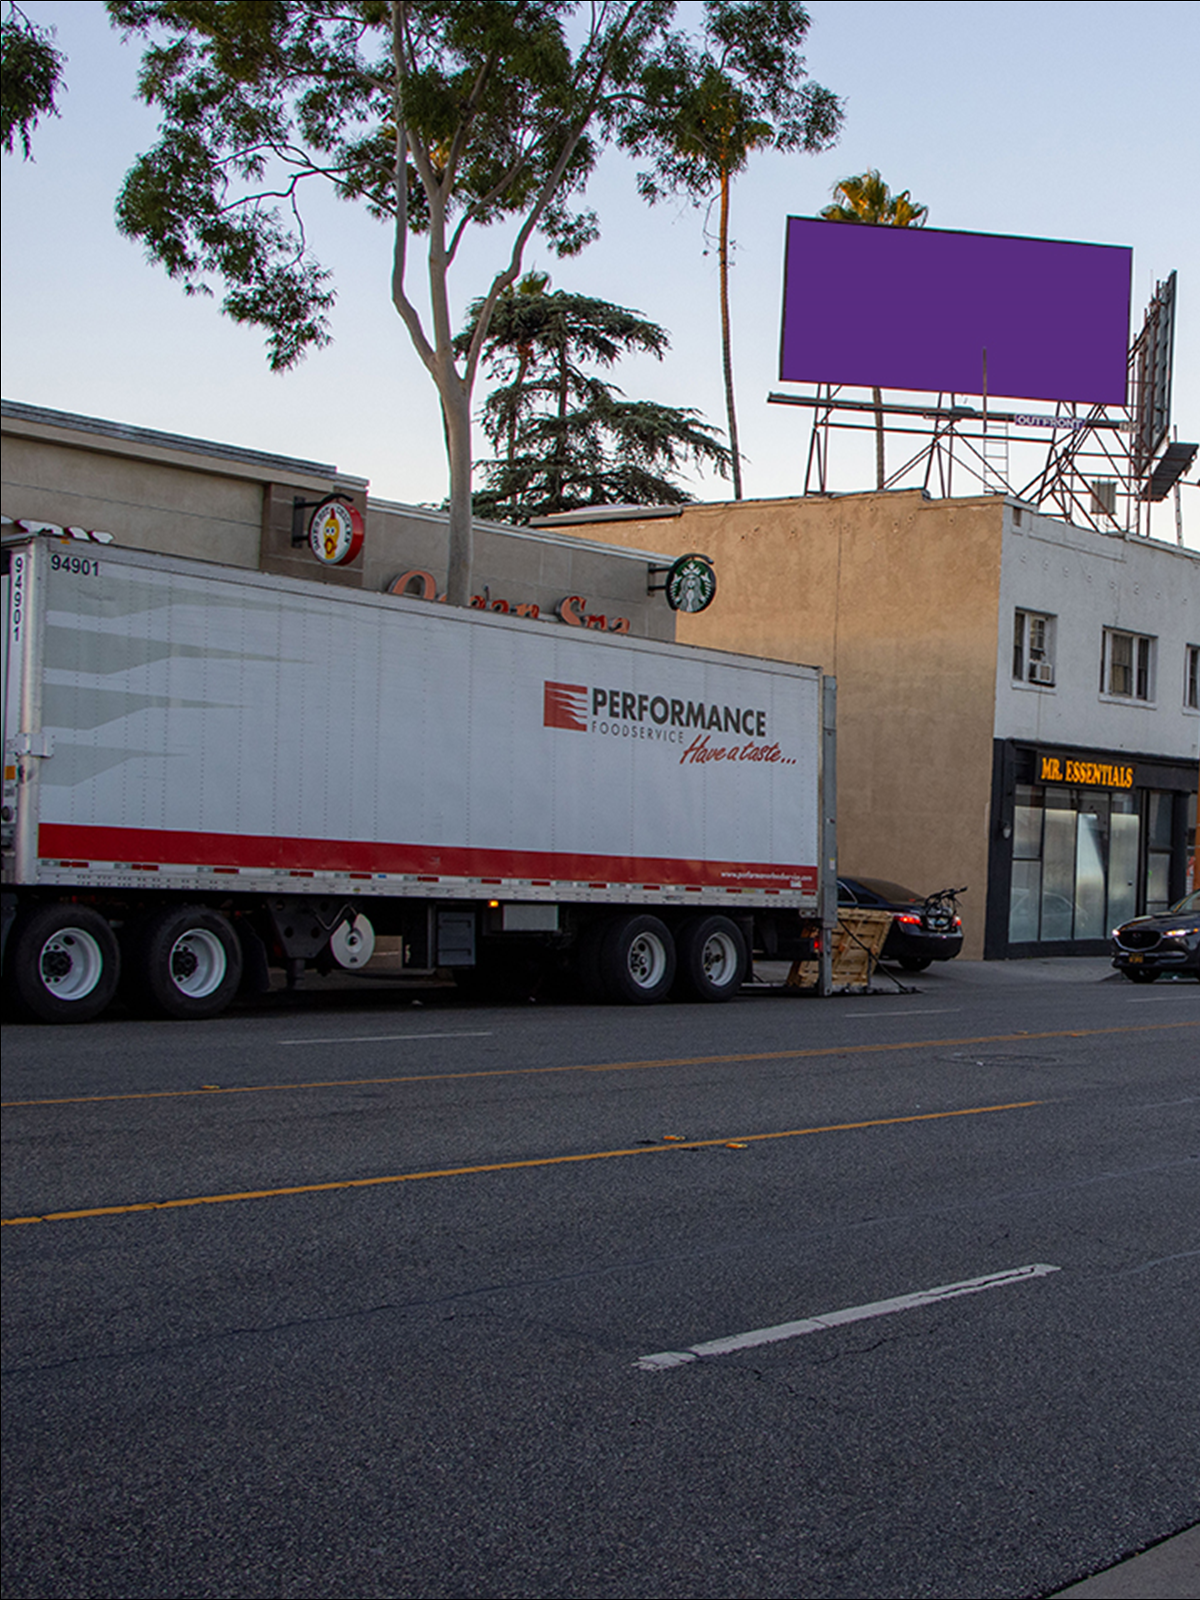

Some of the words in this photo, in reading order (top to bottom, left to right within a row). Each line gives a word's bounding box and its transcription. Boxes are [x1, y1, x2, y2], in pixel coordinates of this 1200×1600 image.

[1017, 415, 1082, 430] OUTFRONT
[335, 506, 350, 543] CHICKEN
[50, 553, 99, 577] 94901
[13, 556, 23, 642] 94901
[591, 687, 767, 738] PERFORMANCE
[591, 720, 684, 744] FOODSERVICE
[679, 733, 726, 765] Have
[726, 747, 739, 762] a
[1041, 757, 1063, 781] MR.
[1065, 760, 1134, 789] ESSENTIALS
